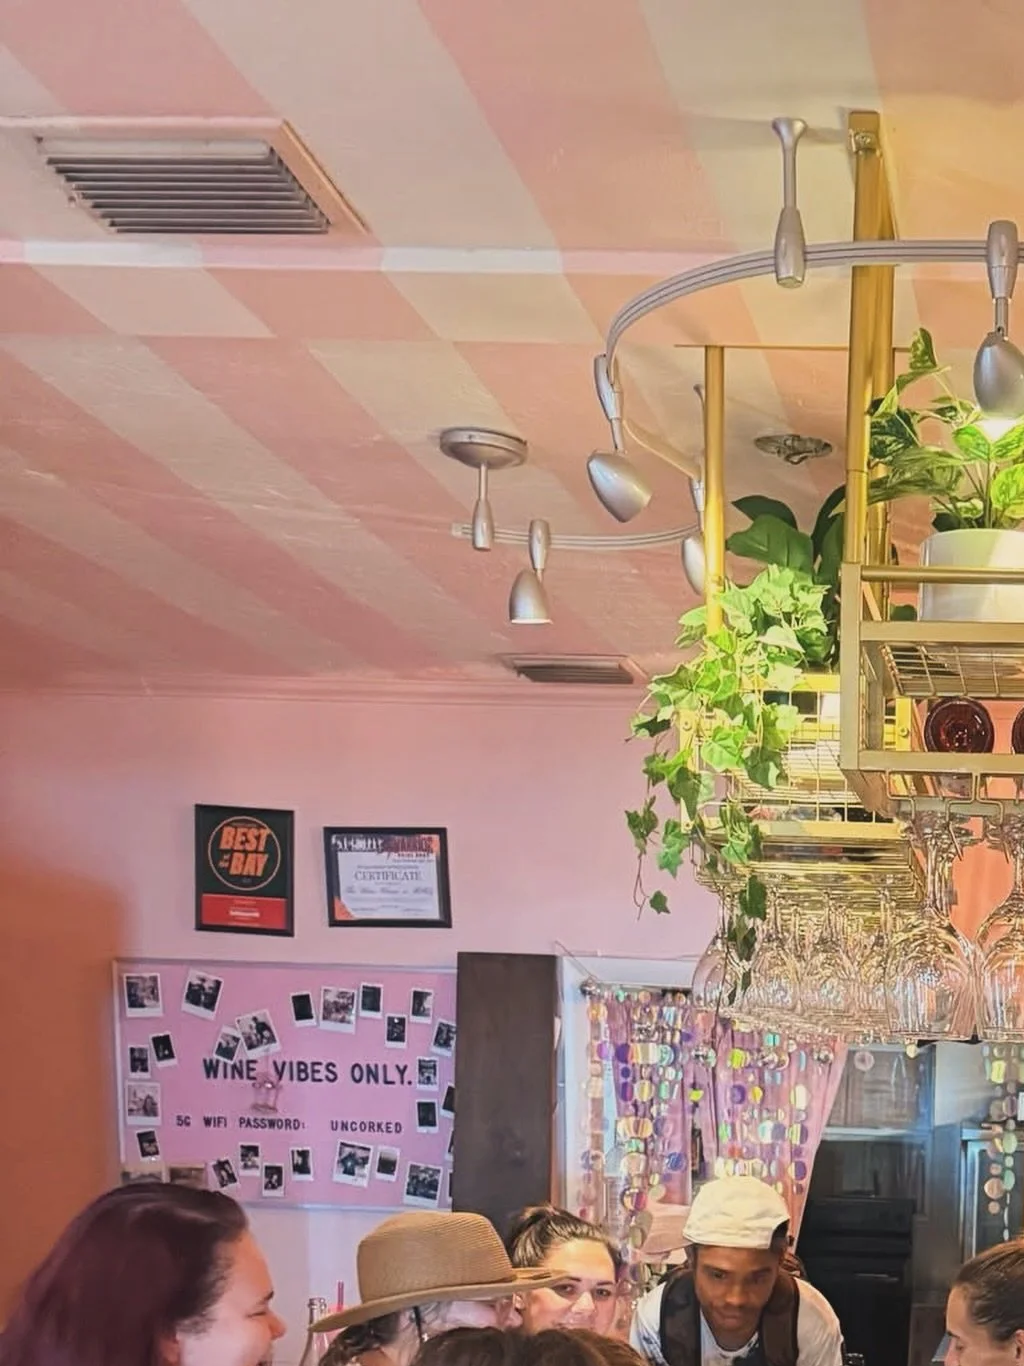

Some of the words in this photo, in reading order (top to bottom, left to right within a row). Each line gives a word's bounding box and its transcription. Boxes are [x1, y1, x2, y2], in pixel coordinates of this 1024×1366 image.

[219, 825, 271, 851] BEST
[229, 852, 269, 877] BAY
[354, 870, 421, 882] CERTIFICATE
[203, 1059, 258, 1081] WINE
[273, 1060, 339, 1083] VIBES
[351, 1063, 414, 1086] ONLY.
[203, 1116, 228, 1128] WIFI
[330, 1120, 402, 1134] UNCORKED
